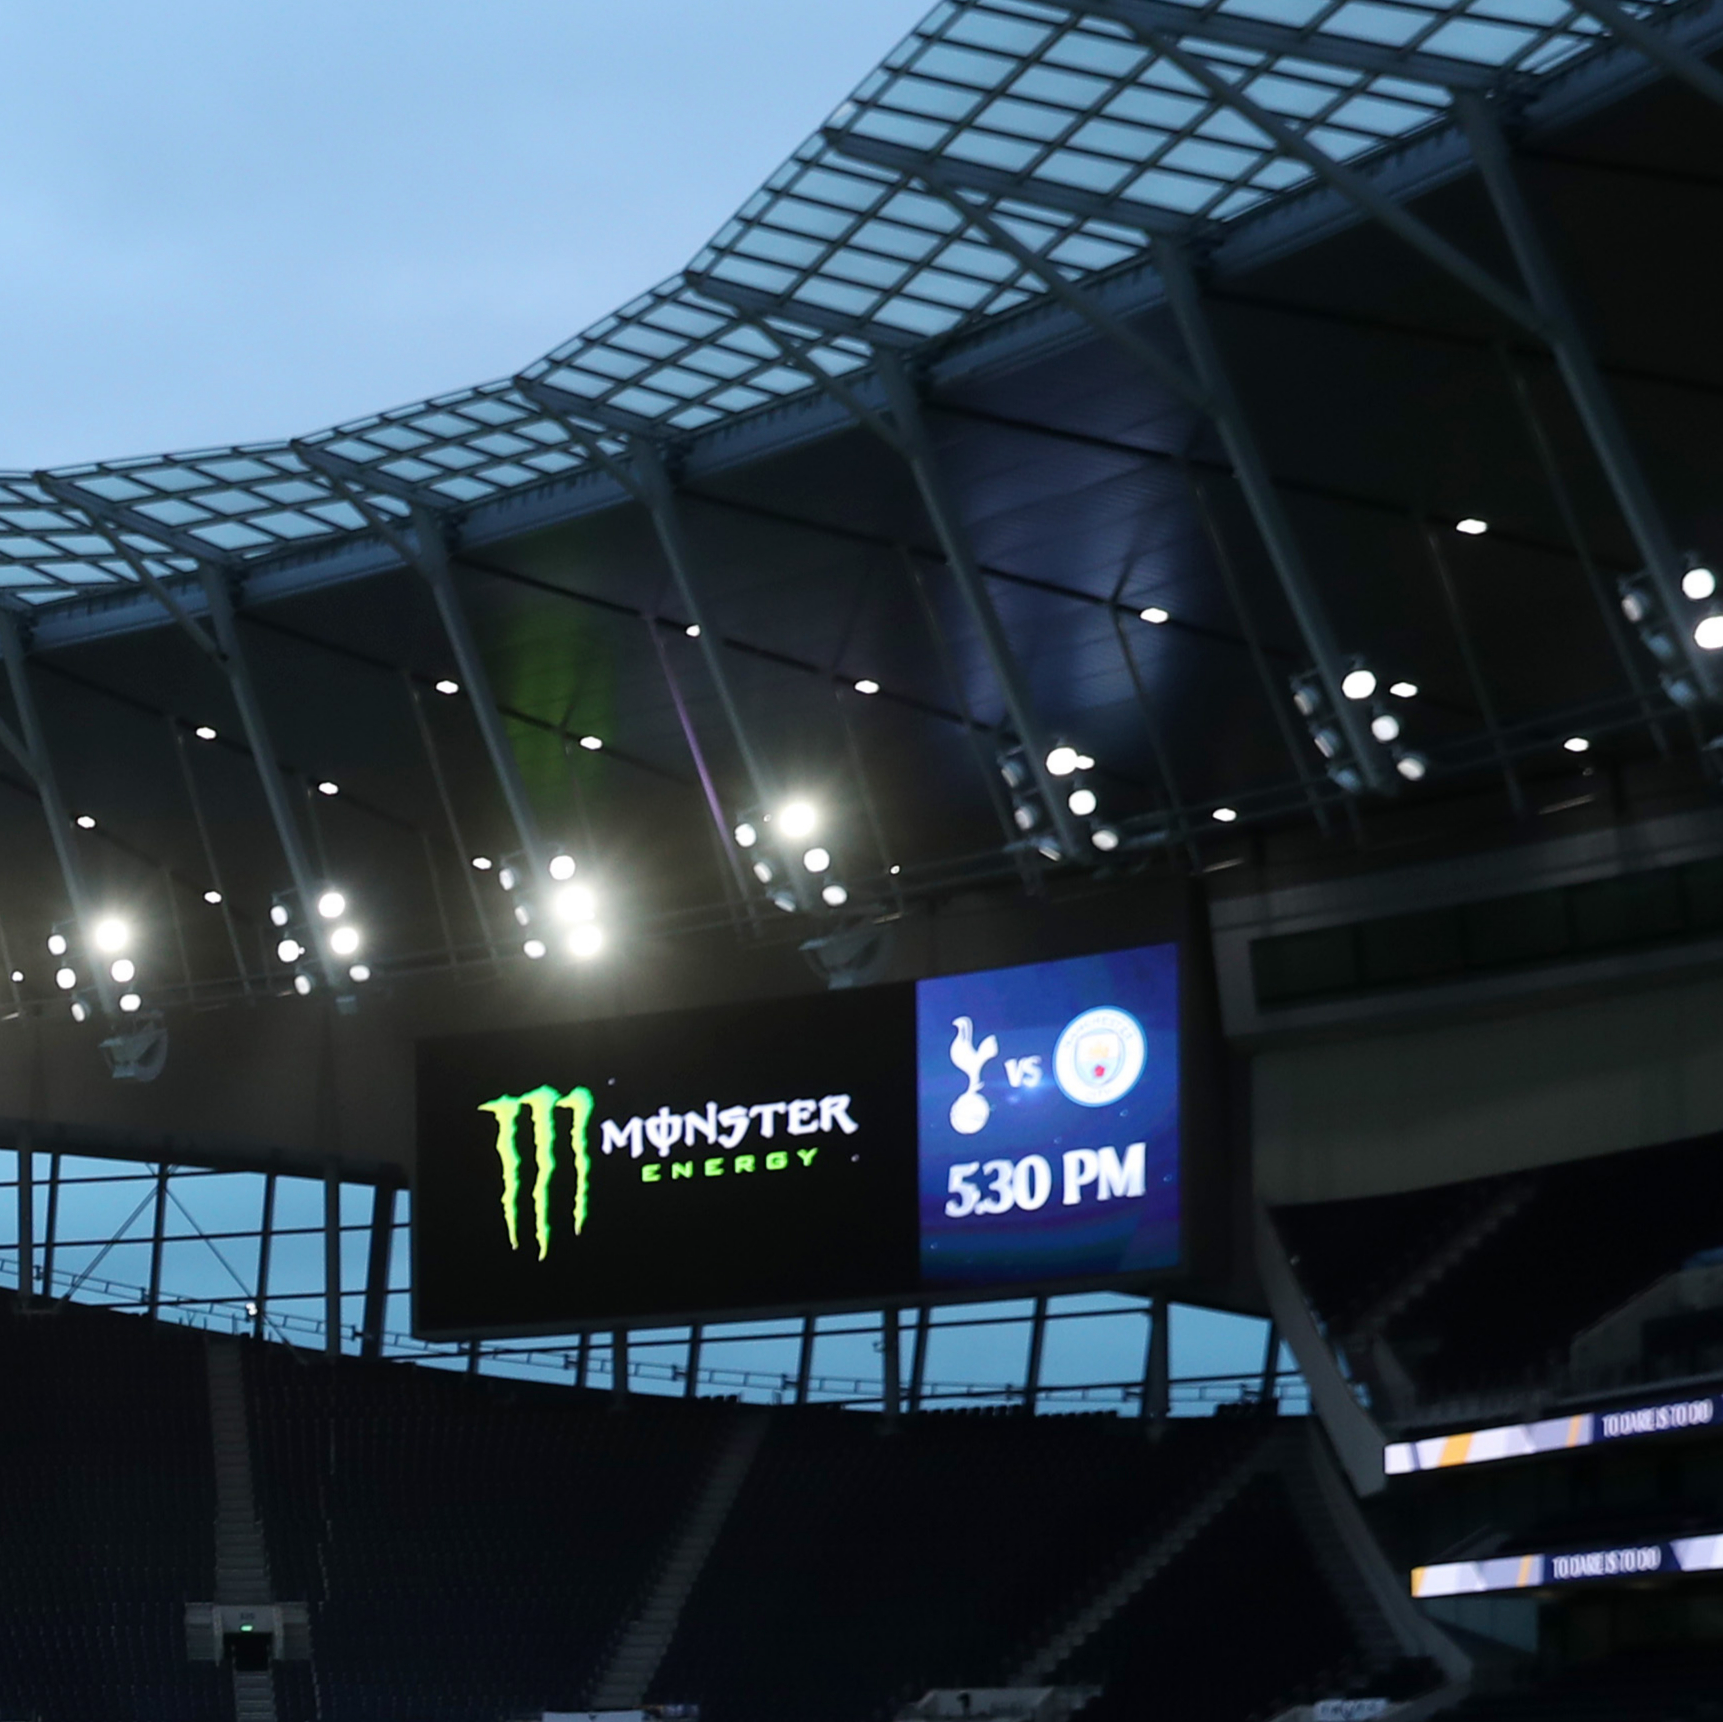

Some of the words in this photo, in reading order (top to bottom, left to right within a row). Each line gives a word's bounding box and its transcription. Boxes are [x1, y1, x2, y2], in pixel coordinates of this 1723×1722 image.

[1005, 1055, 1042, 1088] VS
[601, 1094, 858, 1159] MONSTER
[642, 1147, 818, 1182] ENERGY
[1063, 1142, 1146, 1202] PM
